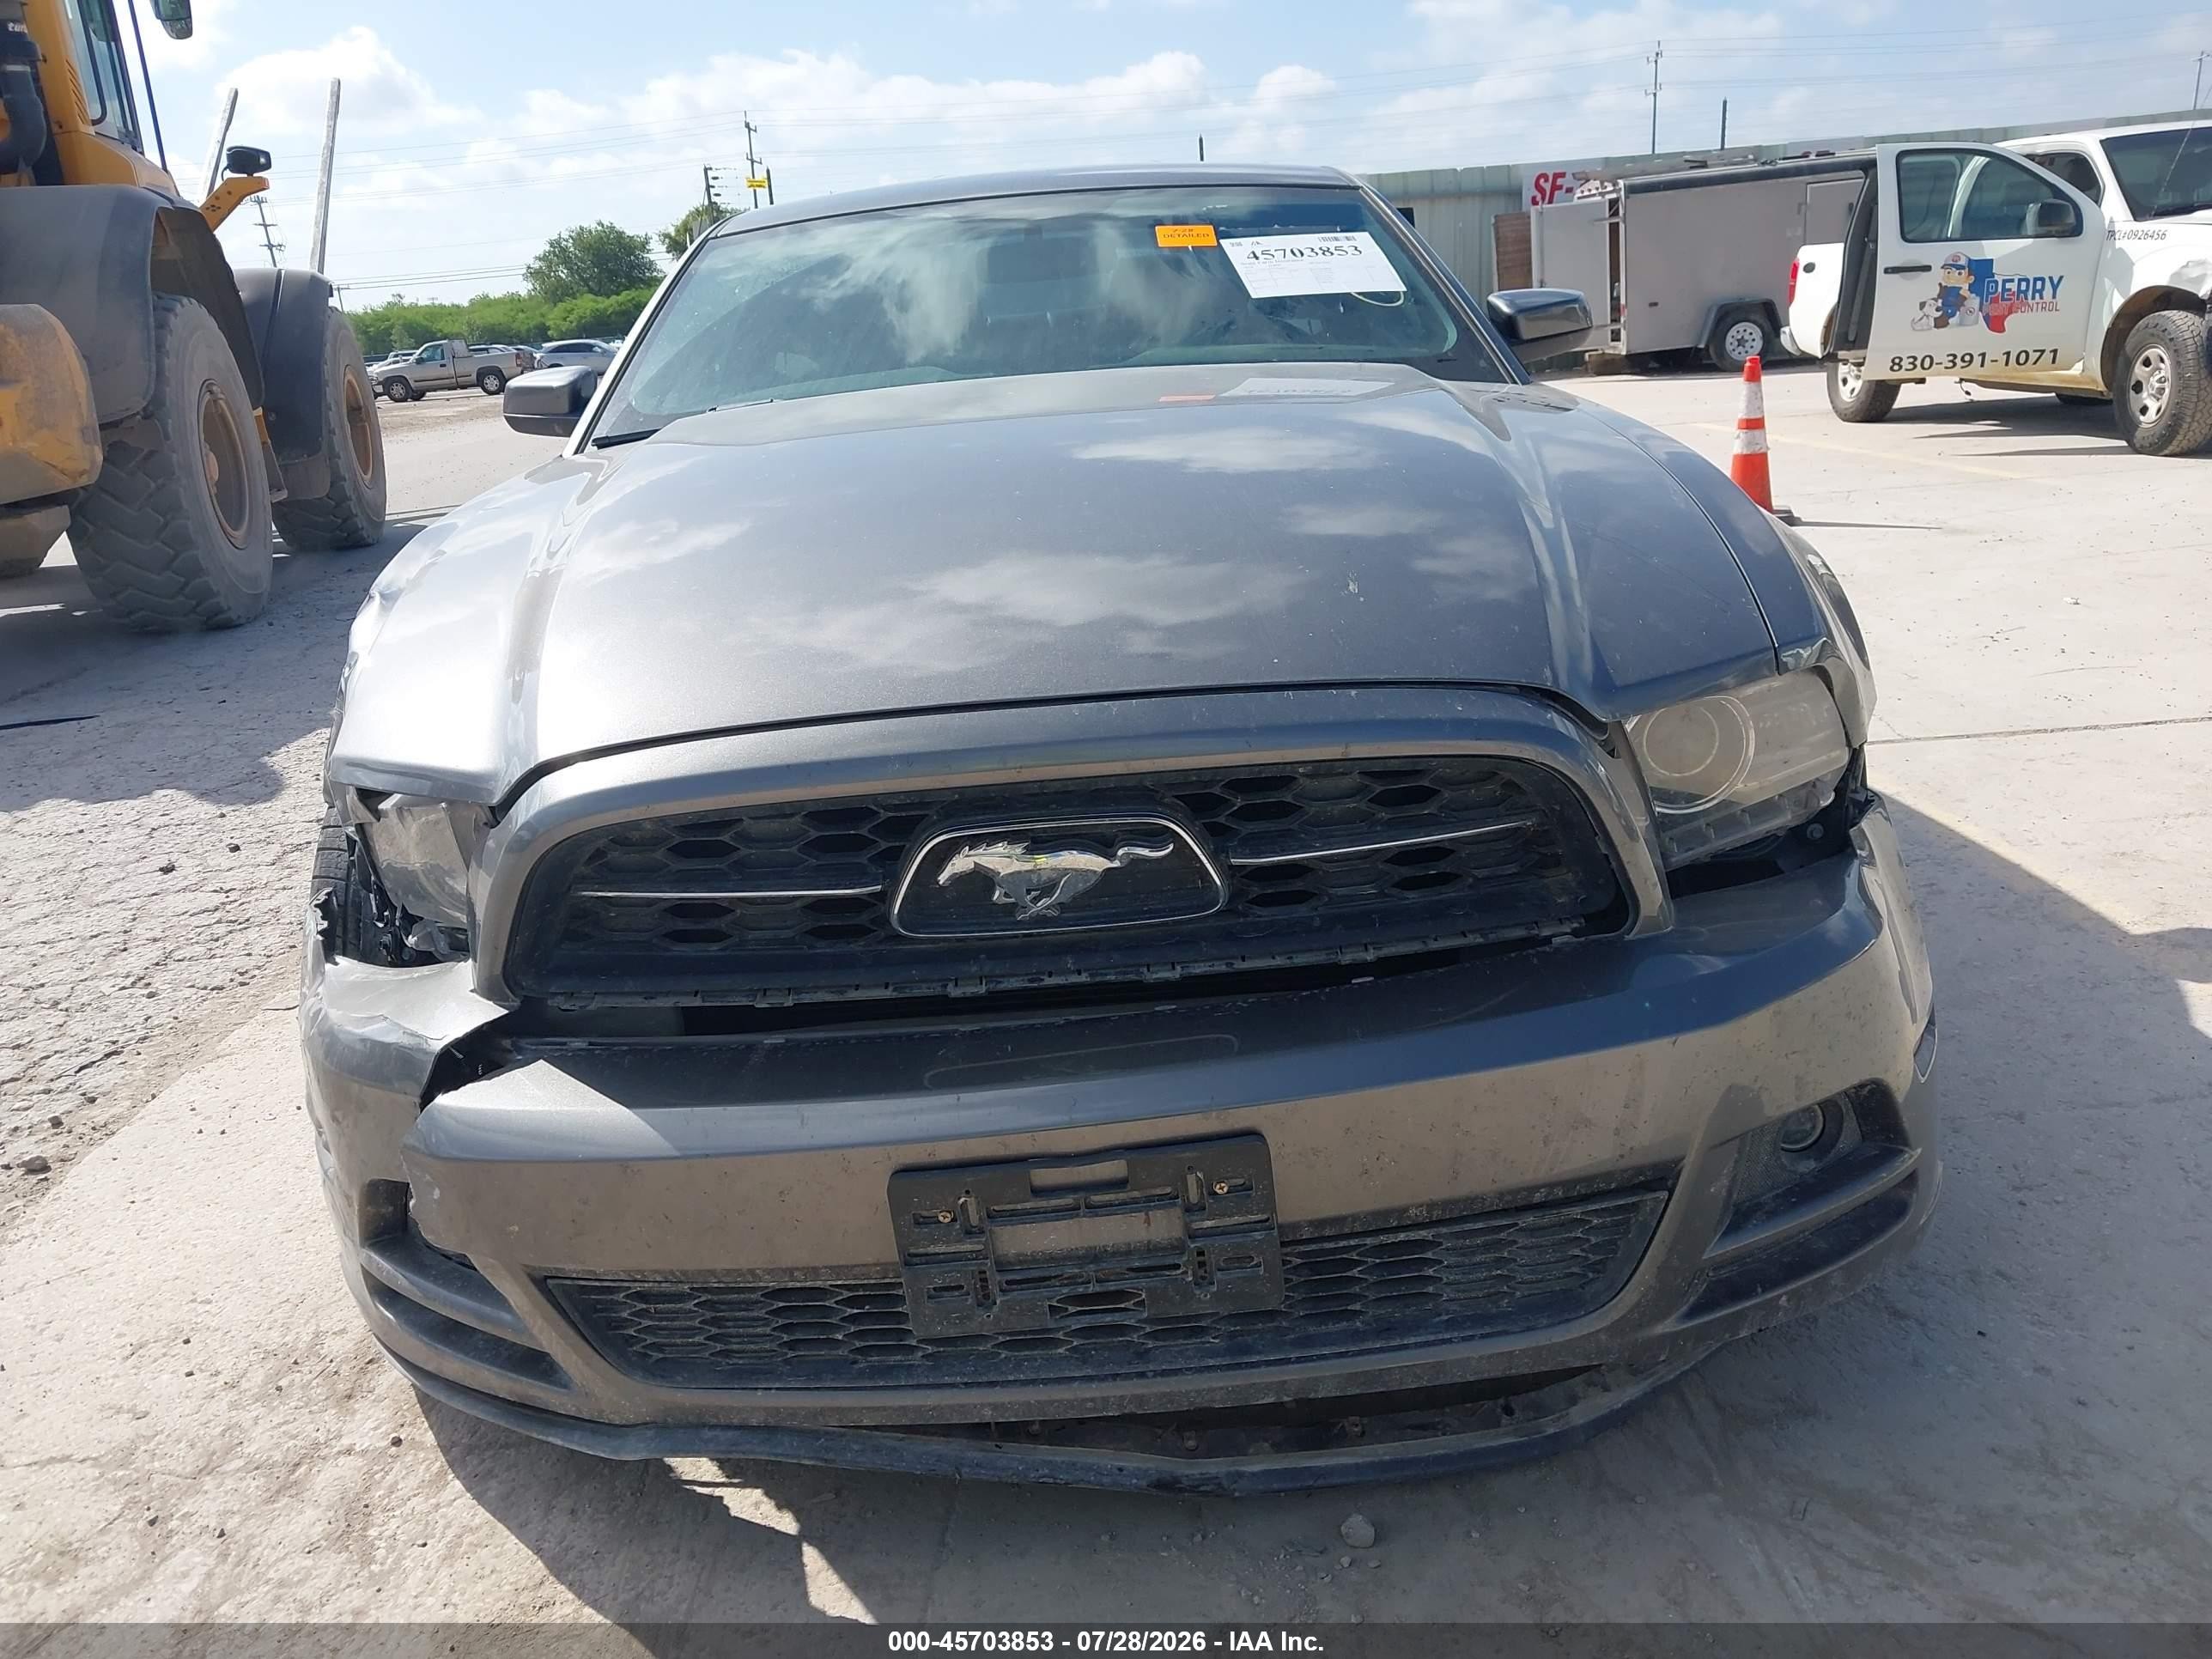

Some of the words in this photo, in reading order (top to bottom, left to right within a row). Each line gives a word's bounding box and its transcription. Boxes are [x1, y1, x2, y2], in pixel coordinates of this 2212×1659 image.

[1247, 245, 1363, 261] 45703853
[1984, 275, 2064, 303] PERRY
[2013, 301, 2060, 313] CONTROL
[1889, 348, 2060, 373] 830-391-1071
